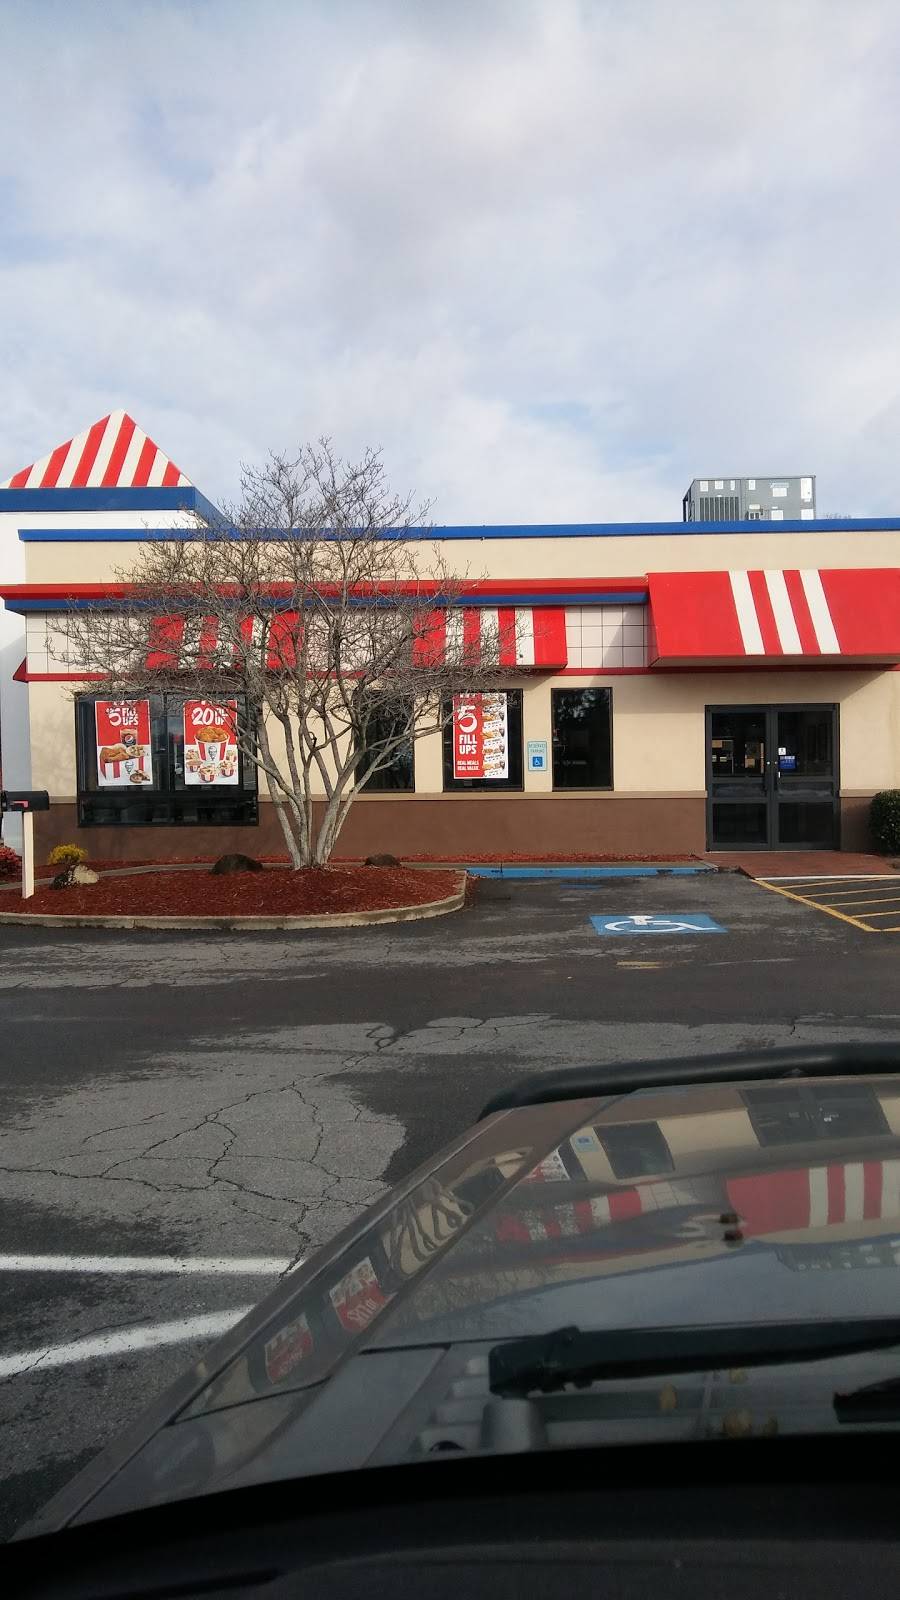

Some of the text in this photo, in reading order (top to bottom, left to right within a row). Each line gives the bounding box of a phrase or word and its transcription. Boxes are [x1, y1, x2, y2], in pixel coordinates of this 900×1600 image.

[122, 715, 139, 726] UPS
[459, 734, 477, 744] FILL
[459, 745, 477, 755] UPS
